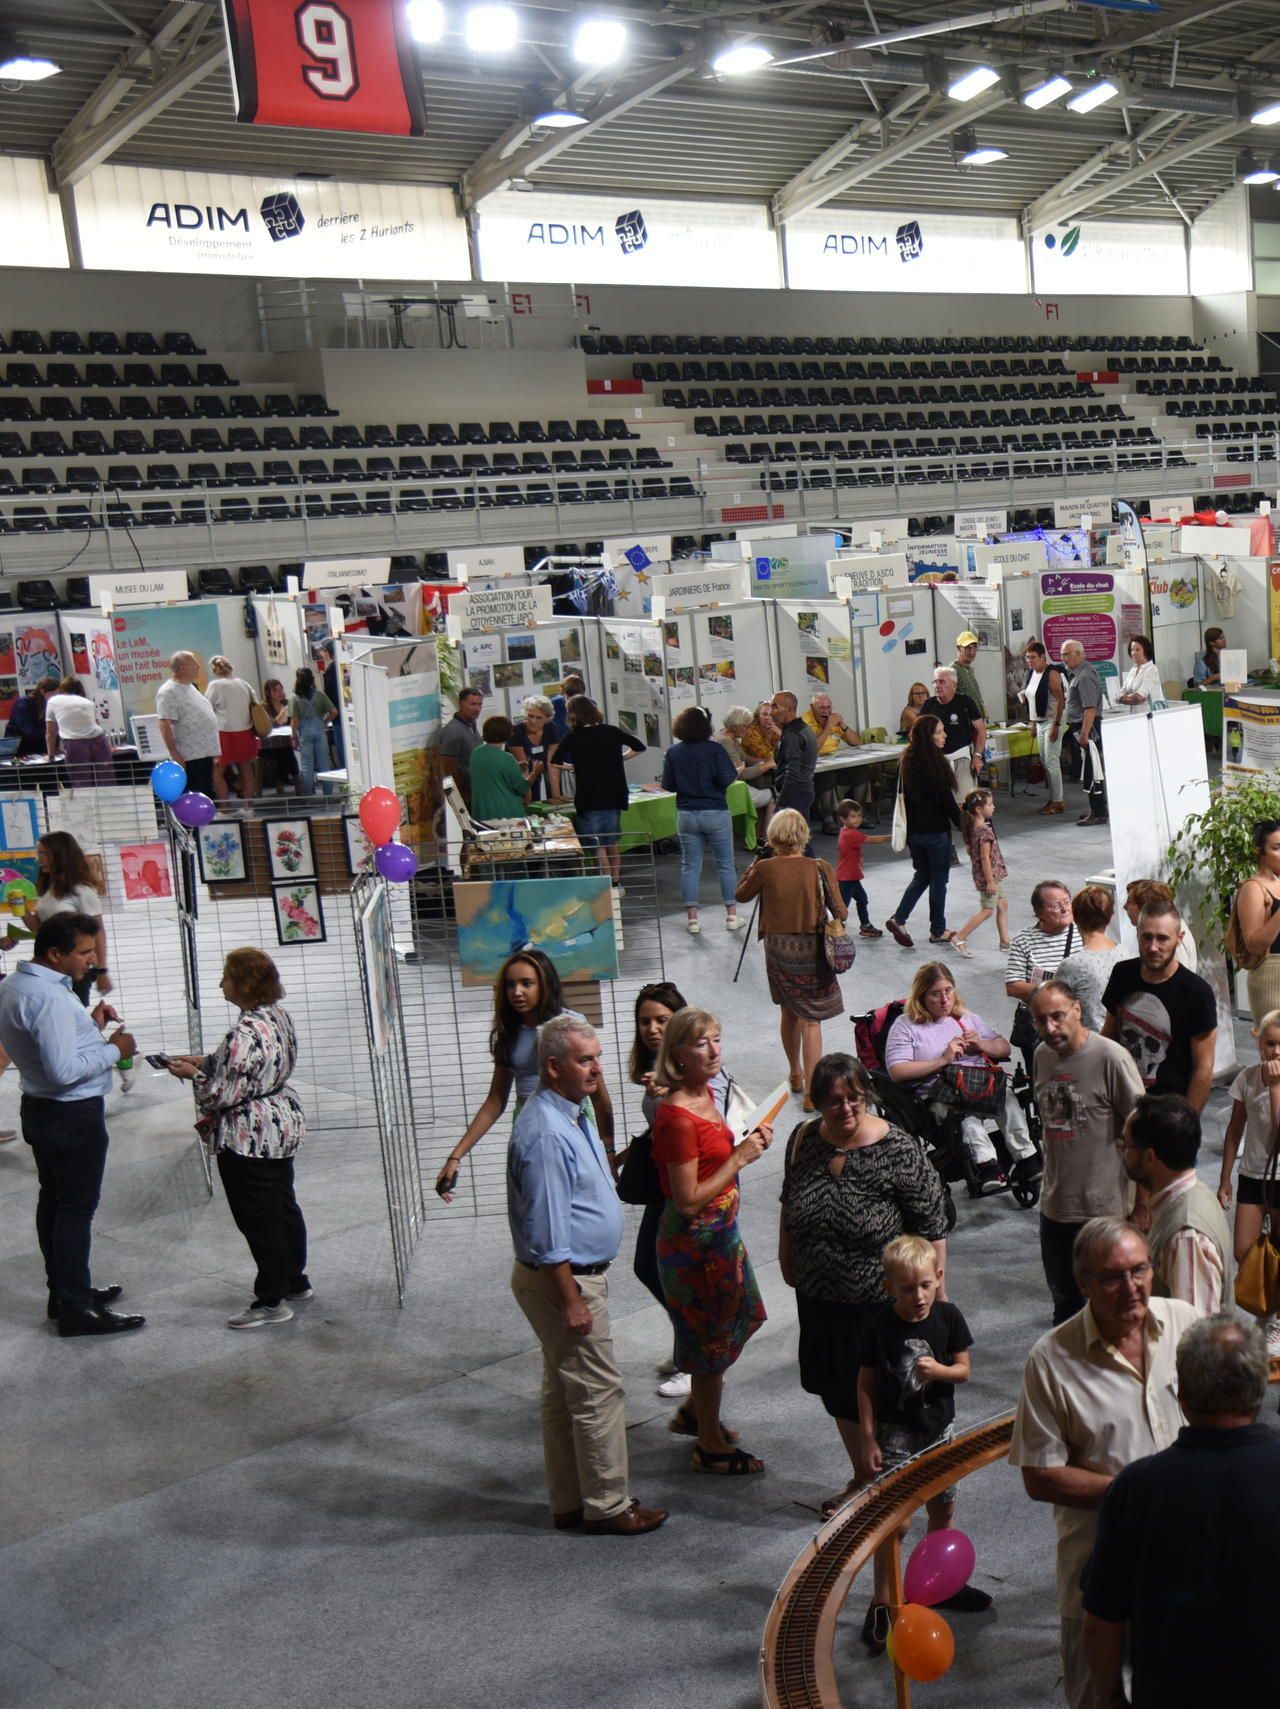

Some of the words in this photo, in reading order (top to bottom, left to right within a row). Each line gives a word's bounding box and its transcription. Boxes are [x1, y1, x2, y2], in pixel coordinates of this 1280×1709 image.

[295, 0, 360, 101] 9
[146, 202, 250, 233] ADIM
[316, 211, 361, 229] derrière
[371, 221, 415, 240] Hurlants
[527, 222, 605, 247] ADIM
[822, 233, 888, 257] ADIM
[511, 293, 532, 315] E1
[1045, 302, 1060, 321] F1
[115, 585, 138, 594] MUSEE
[139, 584, 149, 593] DU
[149, 583, 165, 592] LAM
[667, 584, 702, 598] JARDINIERS
[704, 585, 711, 594] DE
[712, 582, 731, 593] France
[850, 577, 883, 588] RADITION
[469, 591, 514, 604] ASSOCIATION
[514, 589, 533, 600] POUR
[466, 606, 475, 616] LA
[476, 603, 516, 615] PROMOTION
[518, 602, 527, 612] DE
[528, 601, 538, 611] LA
[470, 615, 515, 628] CITOYENNETE
[116, 638, 127, 649] Le
[118, 652, 129, 661] un
[130, 649, 161, 659] musée
[119, 661, 134, 673] qui
[135, 660, 150, 670] fait
[151, 659, 172, 669] bou
[120, 673, 134, 684] les
[135, 672, 163, 684] lignes
